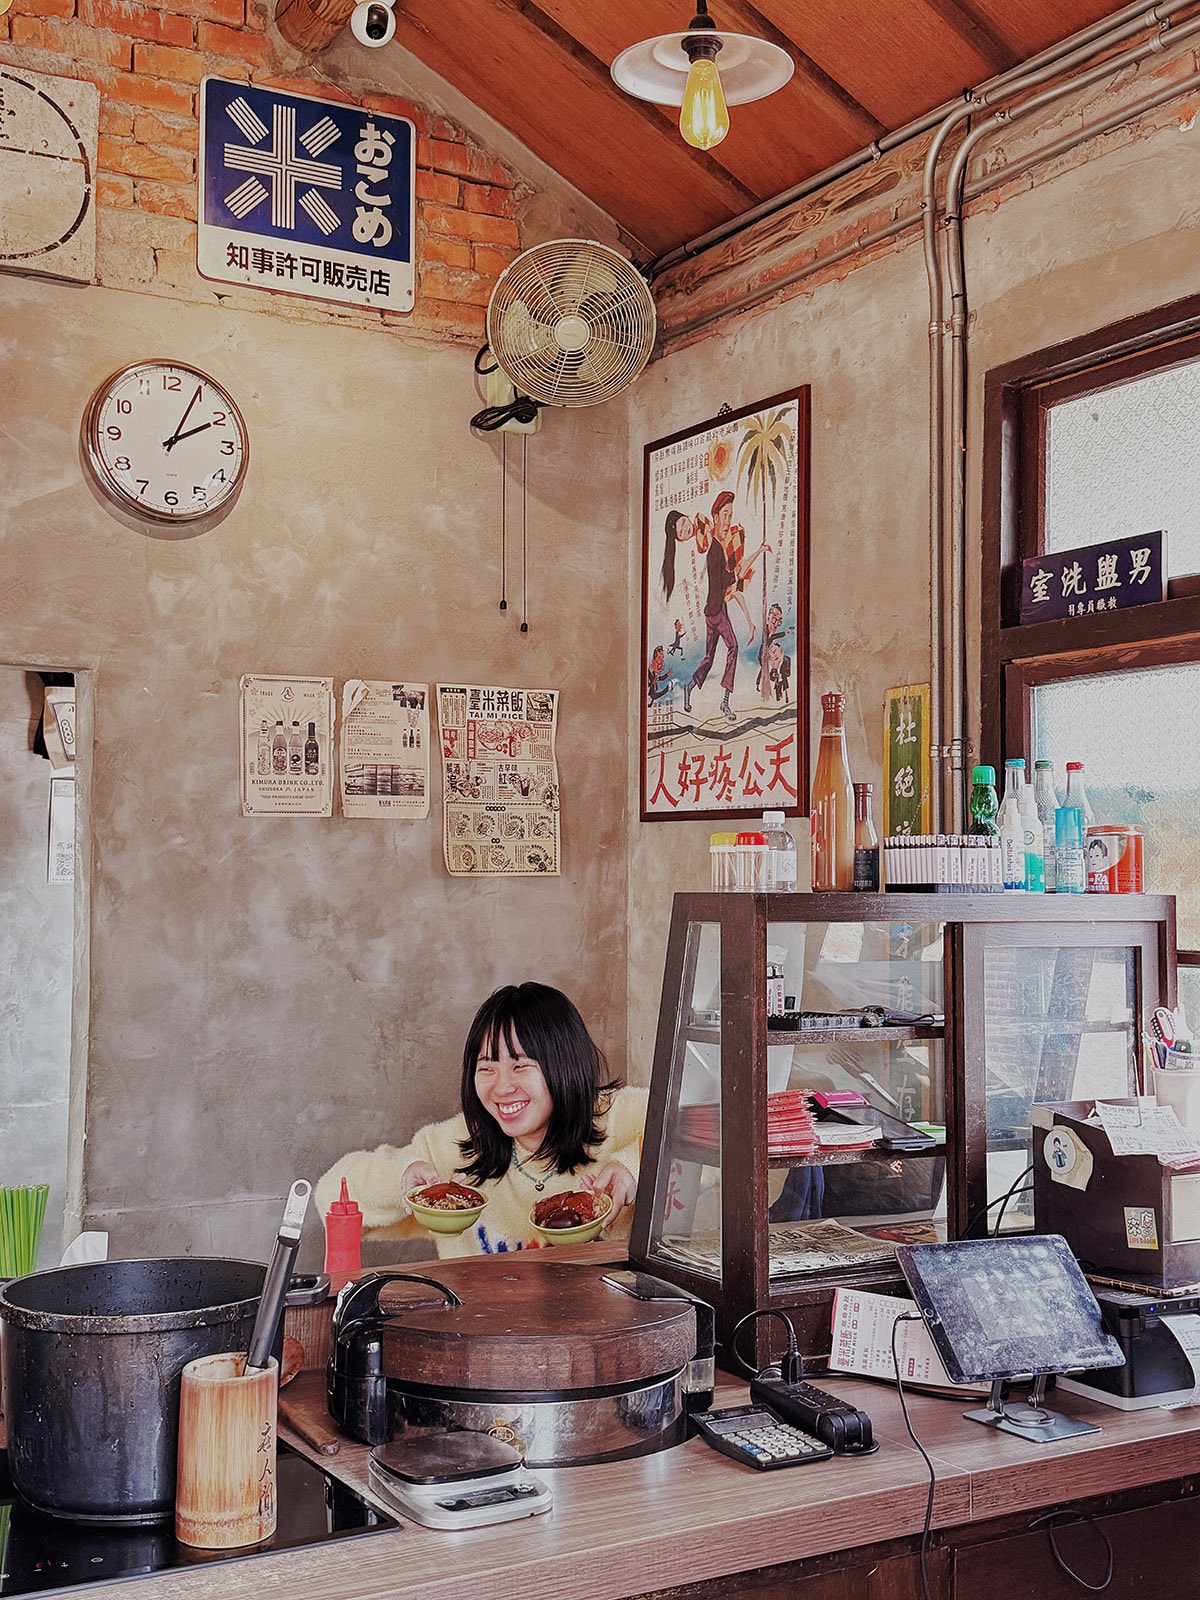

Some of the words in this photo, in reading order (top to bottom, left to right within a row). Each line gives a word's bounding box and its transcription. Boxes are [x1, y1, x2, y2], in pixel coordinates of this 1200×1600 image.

[352, 122, 397, 248] おこめ
[225, 241, 392, 297] 知事許可販売店
[162, 375, 182, 392] 12
[116, 398, 132, 415] 10
[212, 411, 226, 427] 2
[106, 425, 122, 441] 9
[219, 440, 235, 456] 3
[114, 456, 132, 471] 8
[212, 468, 227, 483] 4
[135, 479, 150, 495] 7
[191, 486, 207, 501] 5
[164, 491, 179, 506] 6
[1030, 547, 1152, 603] 男盥洗室
[469, 711, 483, 719] TAI
[501, 712, 524, 720] RICE
[498, 772, 520, 785] 紅茶
[649, 733, 797, 808] 天公疼好人
